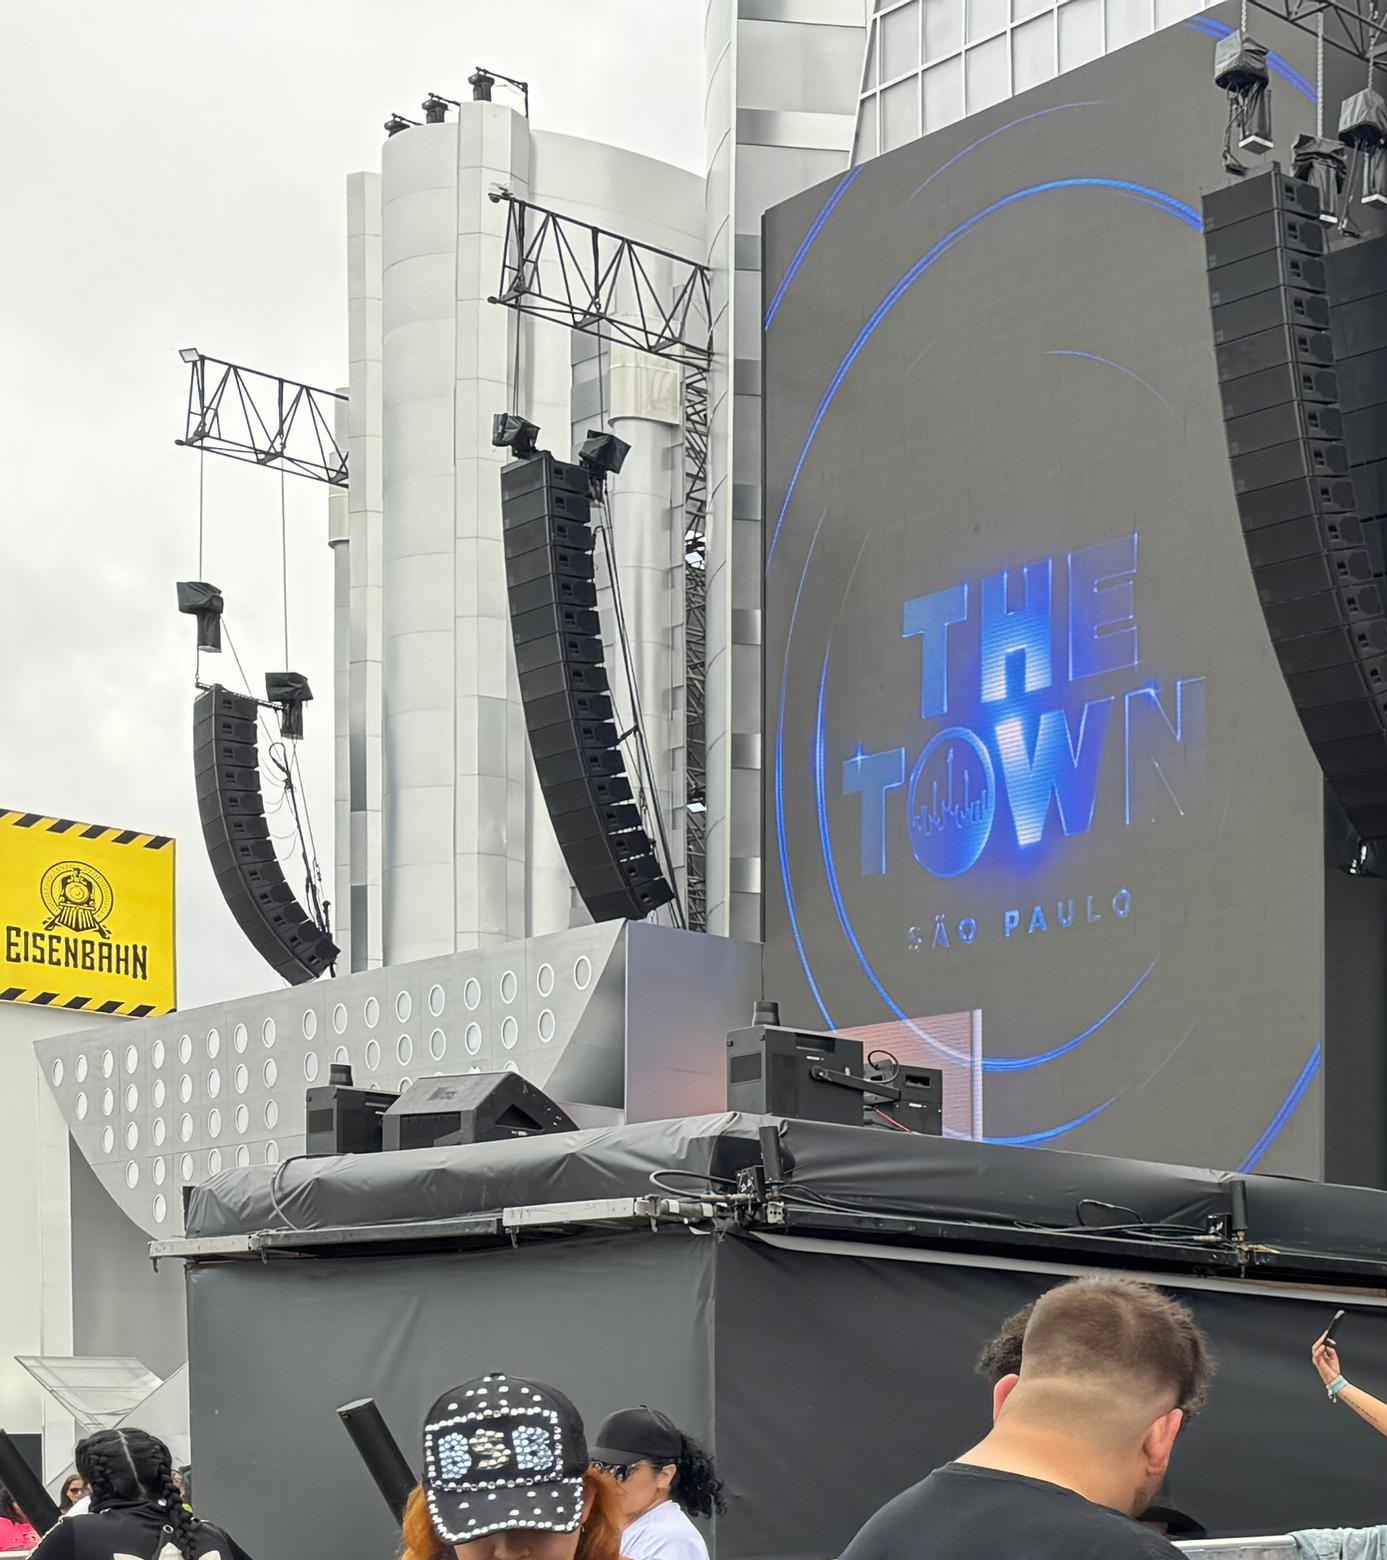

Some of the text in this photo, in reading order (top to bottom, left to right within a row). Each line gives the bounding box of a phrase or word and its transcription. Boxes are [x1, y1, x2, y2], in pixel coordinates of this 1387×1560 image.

[903, 532, 1138, 718] THE
[842, 677, 1206, 877] TOWN
[1003, 887, 1132, 938] PAULO
[5, 925, 148, 980] EISENBAHN
[438, 1425, 555, 1479] BSB
